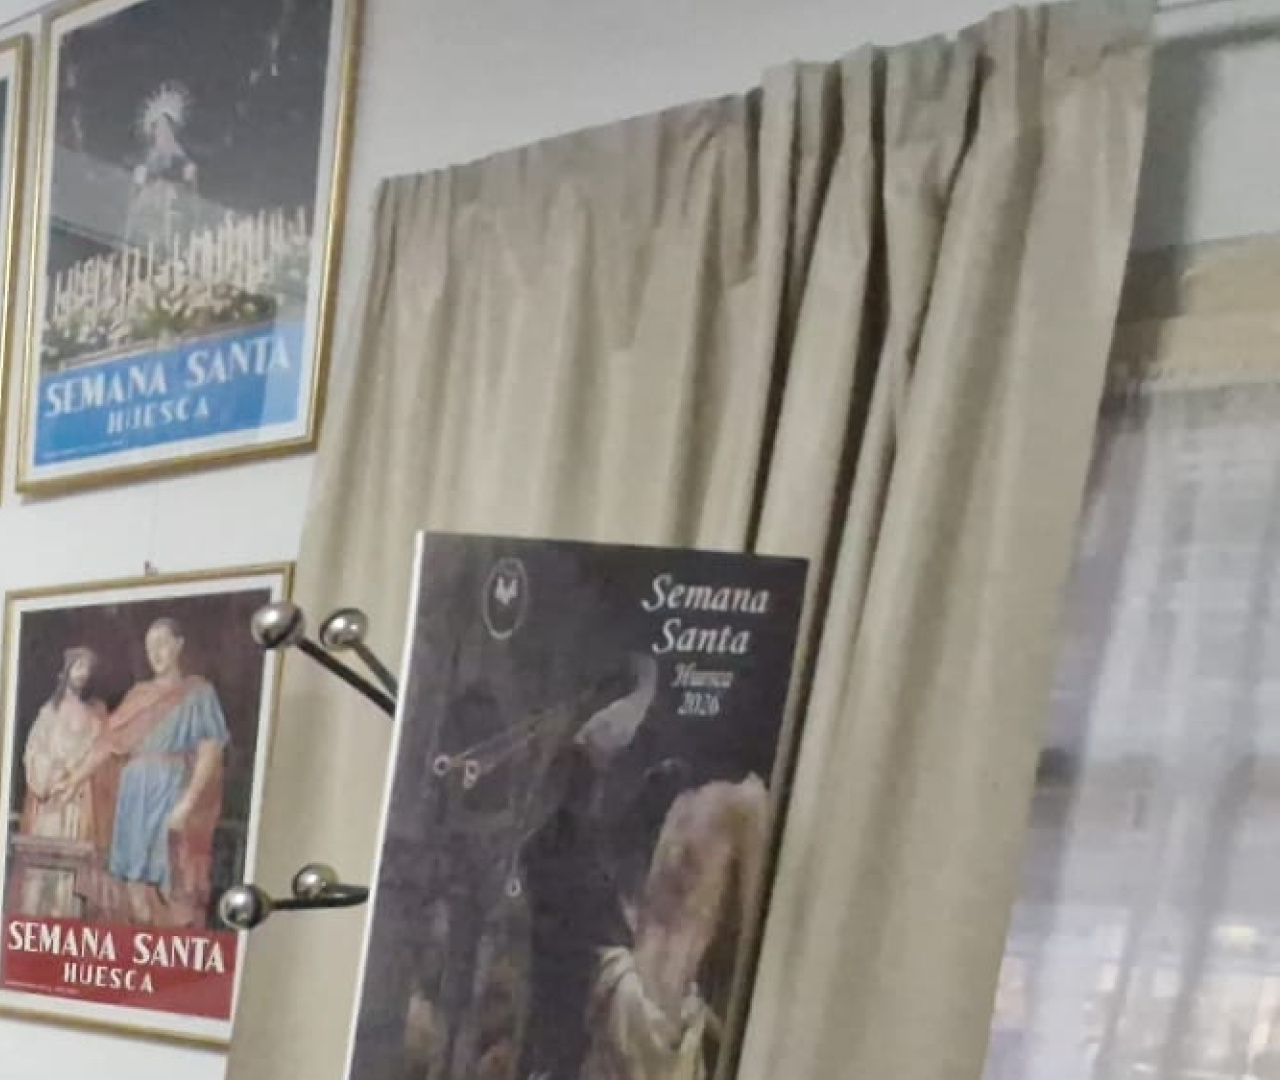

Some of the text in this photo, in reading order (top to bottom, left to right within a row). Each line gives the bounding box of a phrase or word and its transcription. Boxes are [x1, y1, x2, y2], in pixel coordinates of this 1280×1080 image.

[45, 337, 289, 416] SEMANA SANTA
[107, 397, 209, 433] HUESCA
[642, 573, 770, 615] Semana
[652, 618, 751, 655] Santa
[8, 920, 224, 973] SEMANA SANTA
[64, 962, 153, 993] HUESCA
